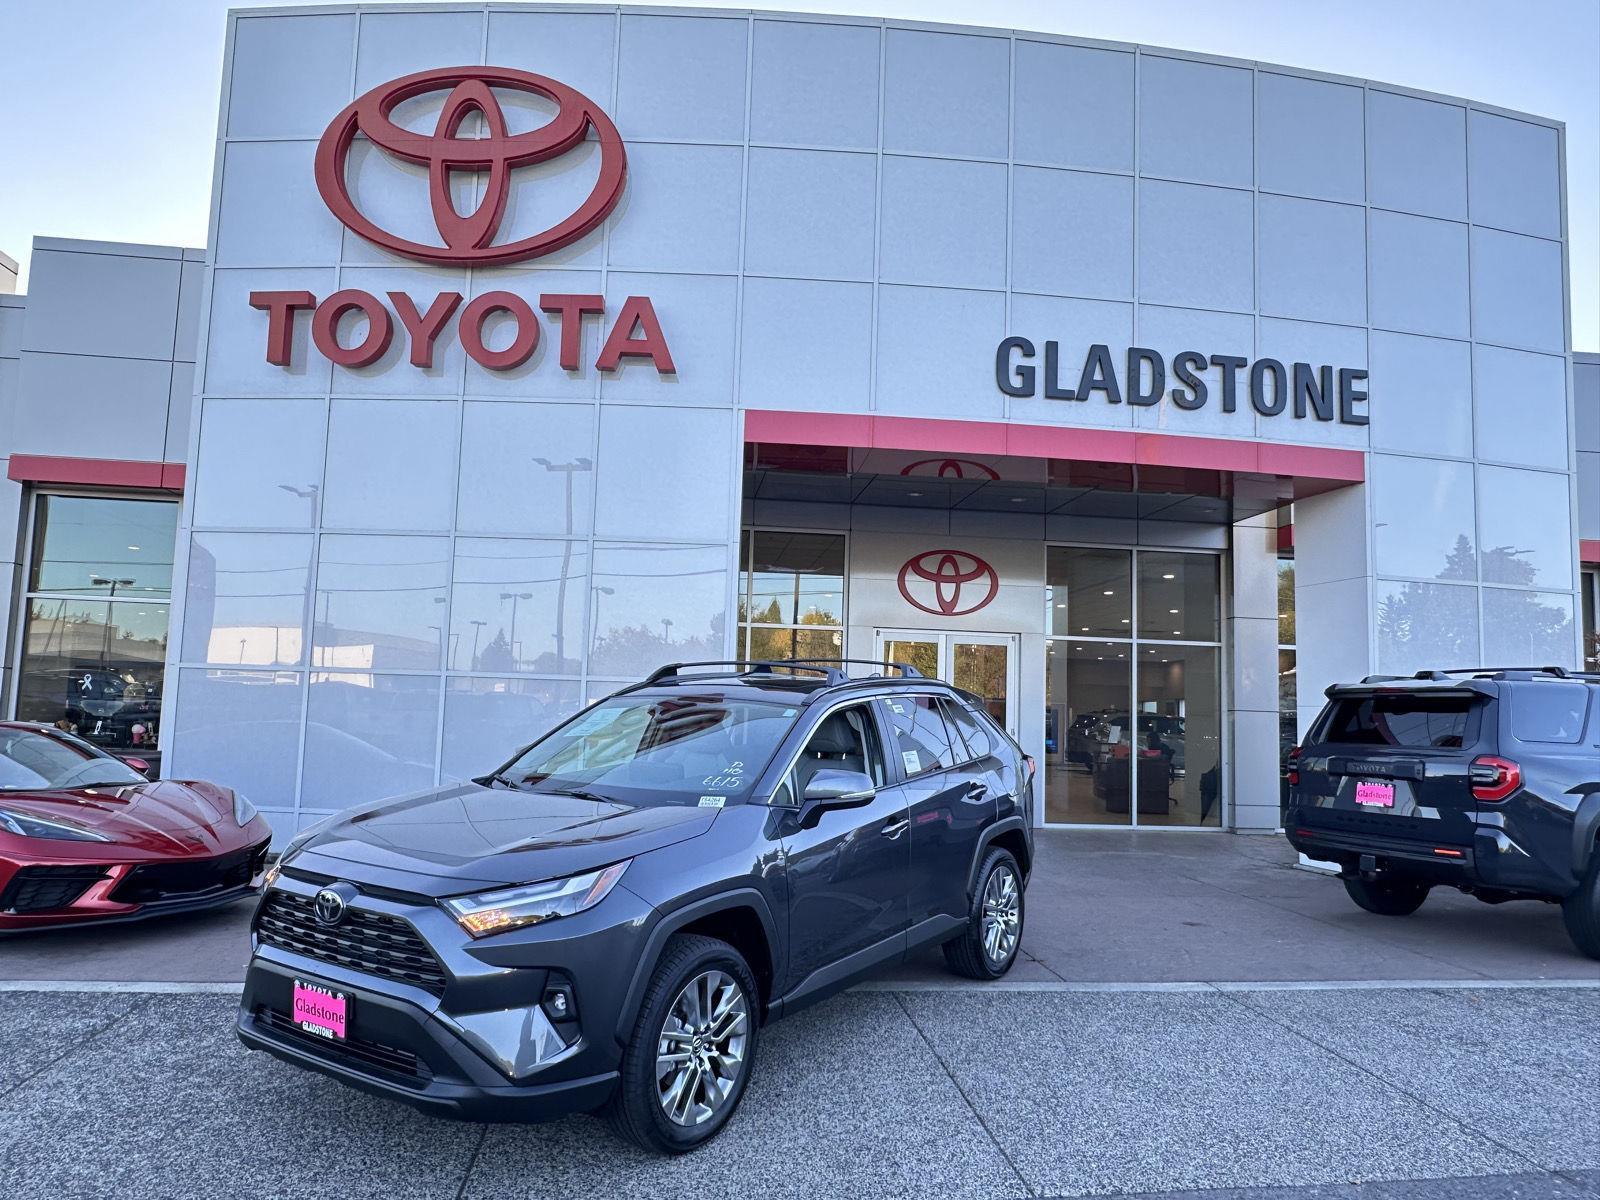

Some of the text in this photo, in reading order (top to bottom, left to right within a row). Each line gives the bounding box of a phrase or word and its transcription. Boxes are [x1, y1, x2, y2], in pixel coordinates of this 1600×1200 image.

[249, 288, 677, 375] TOYOTA
[995, 335, 1370, 426] GLADSTONE
[303, 982, 333, 998] TOYOTA
[295, 998, 345, 1024] Gladstone
[302, 1020, 334, 1039] GLADSTONE
